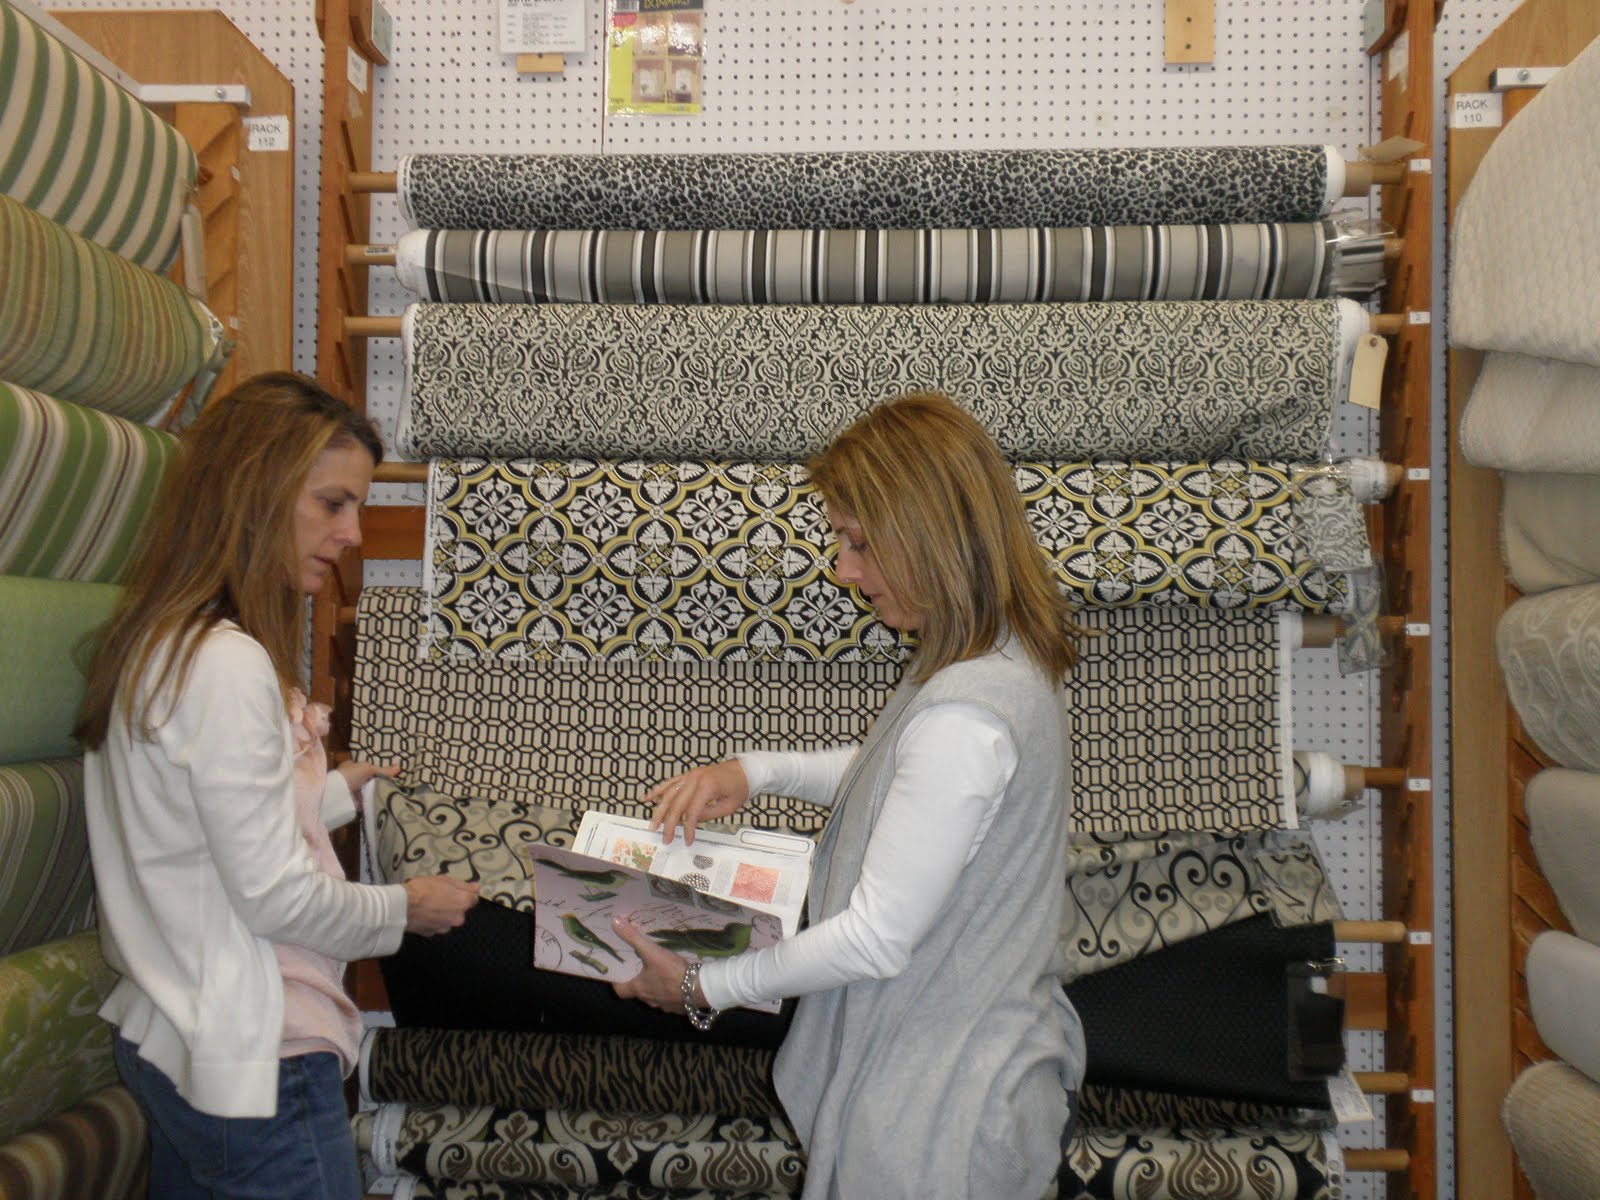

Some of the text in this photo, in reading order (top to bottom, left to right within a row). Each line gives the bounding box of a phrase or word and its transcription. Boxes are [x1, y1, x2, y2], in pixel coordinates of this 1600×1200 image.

[1456, 99, 1488, 110] RACK
[1463, 113, 1482, 122] 110
[252, 123, 281, 133] RACK
